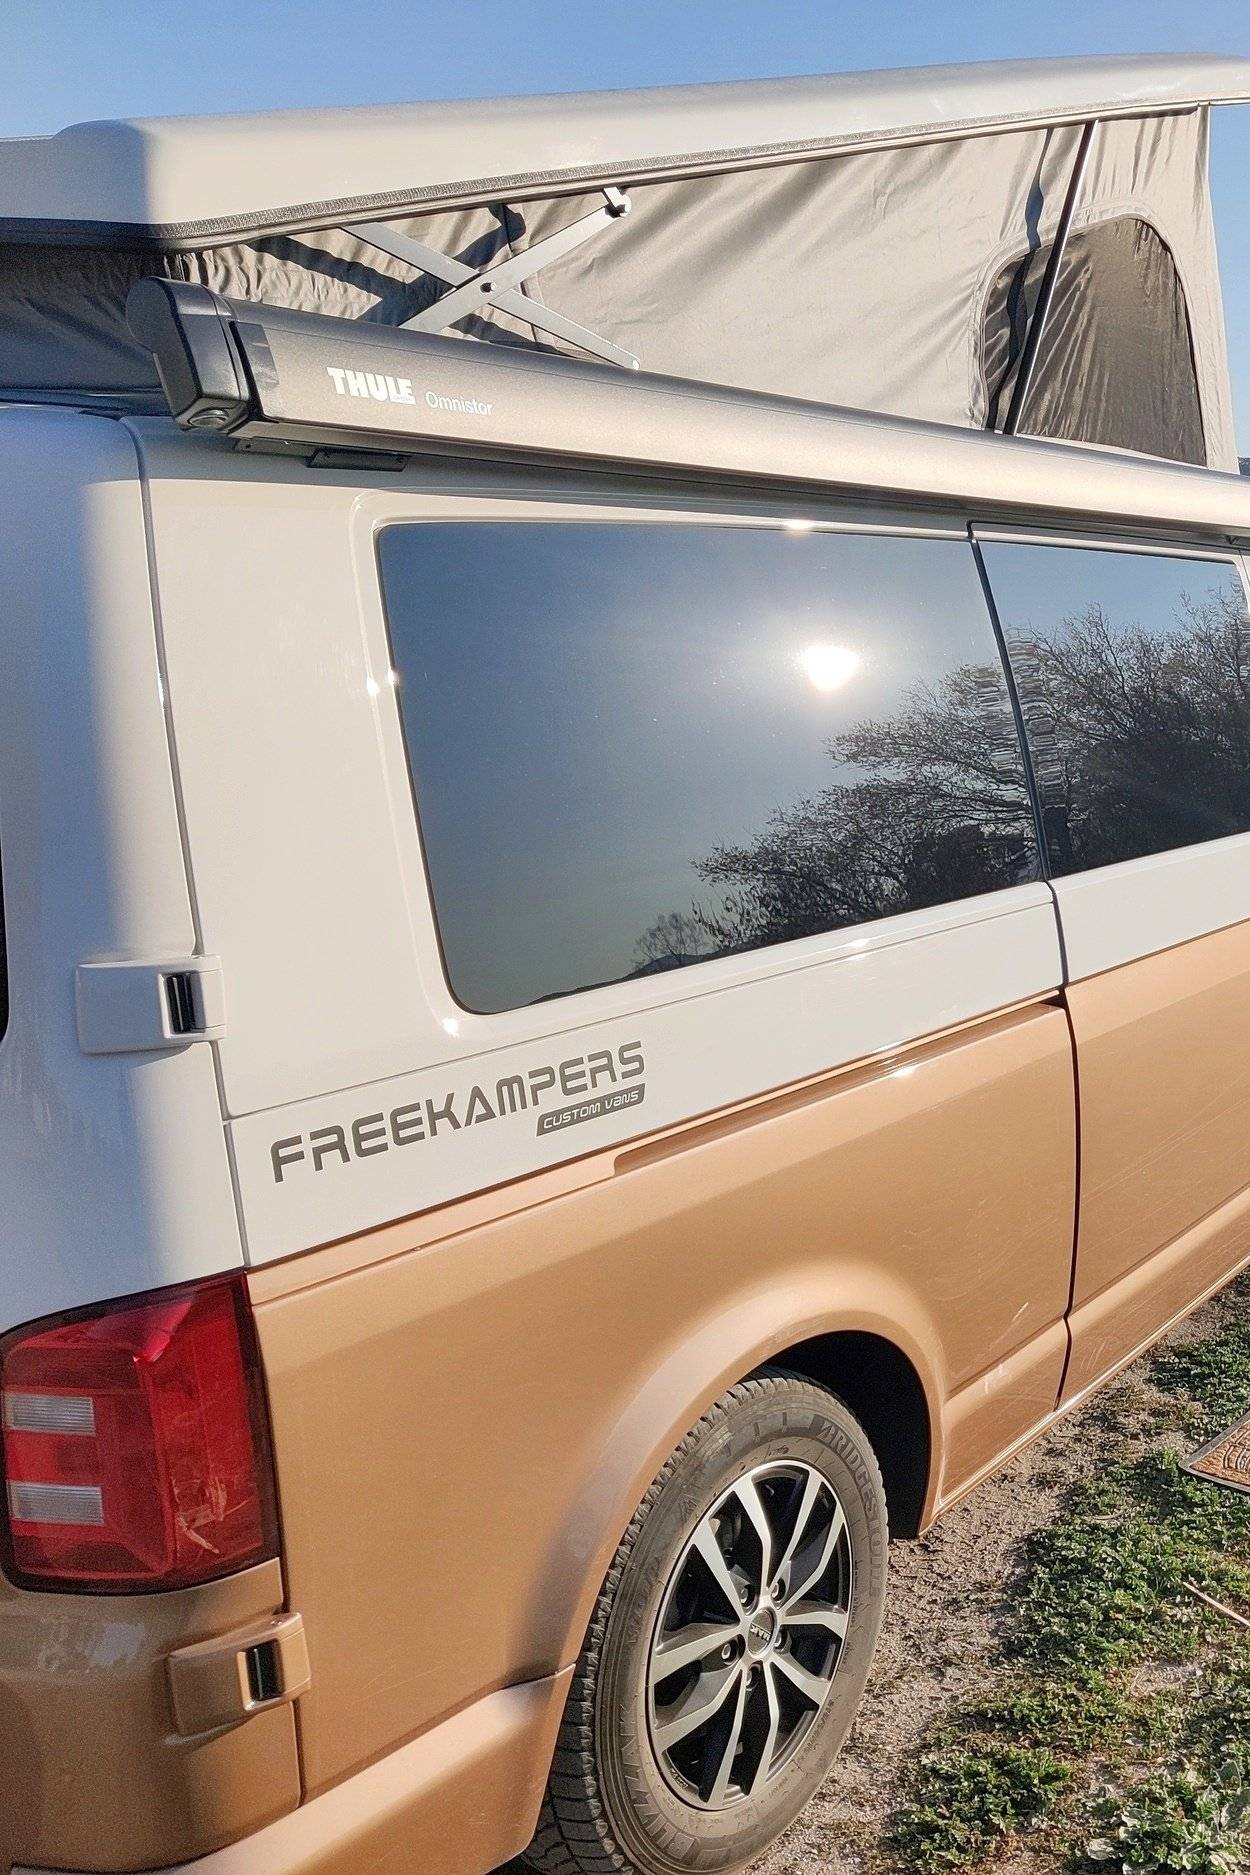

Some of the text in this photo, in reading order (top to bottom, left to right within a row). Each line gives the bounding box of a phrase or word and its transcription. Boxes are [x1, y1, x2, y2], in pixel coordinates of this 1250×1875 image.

[327, 367, 492, 416] THULE Omnistor
[270, 1041, 645, 1183] FREEKAMPERS
[543, 1103, 600, 1129] CUSTOM
